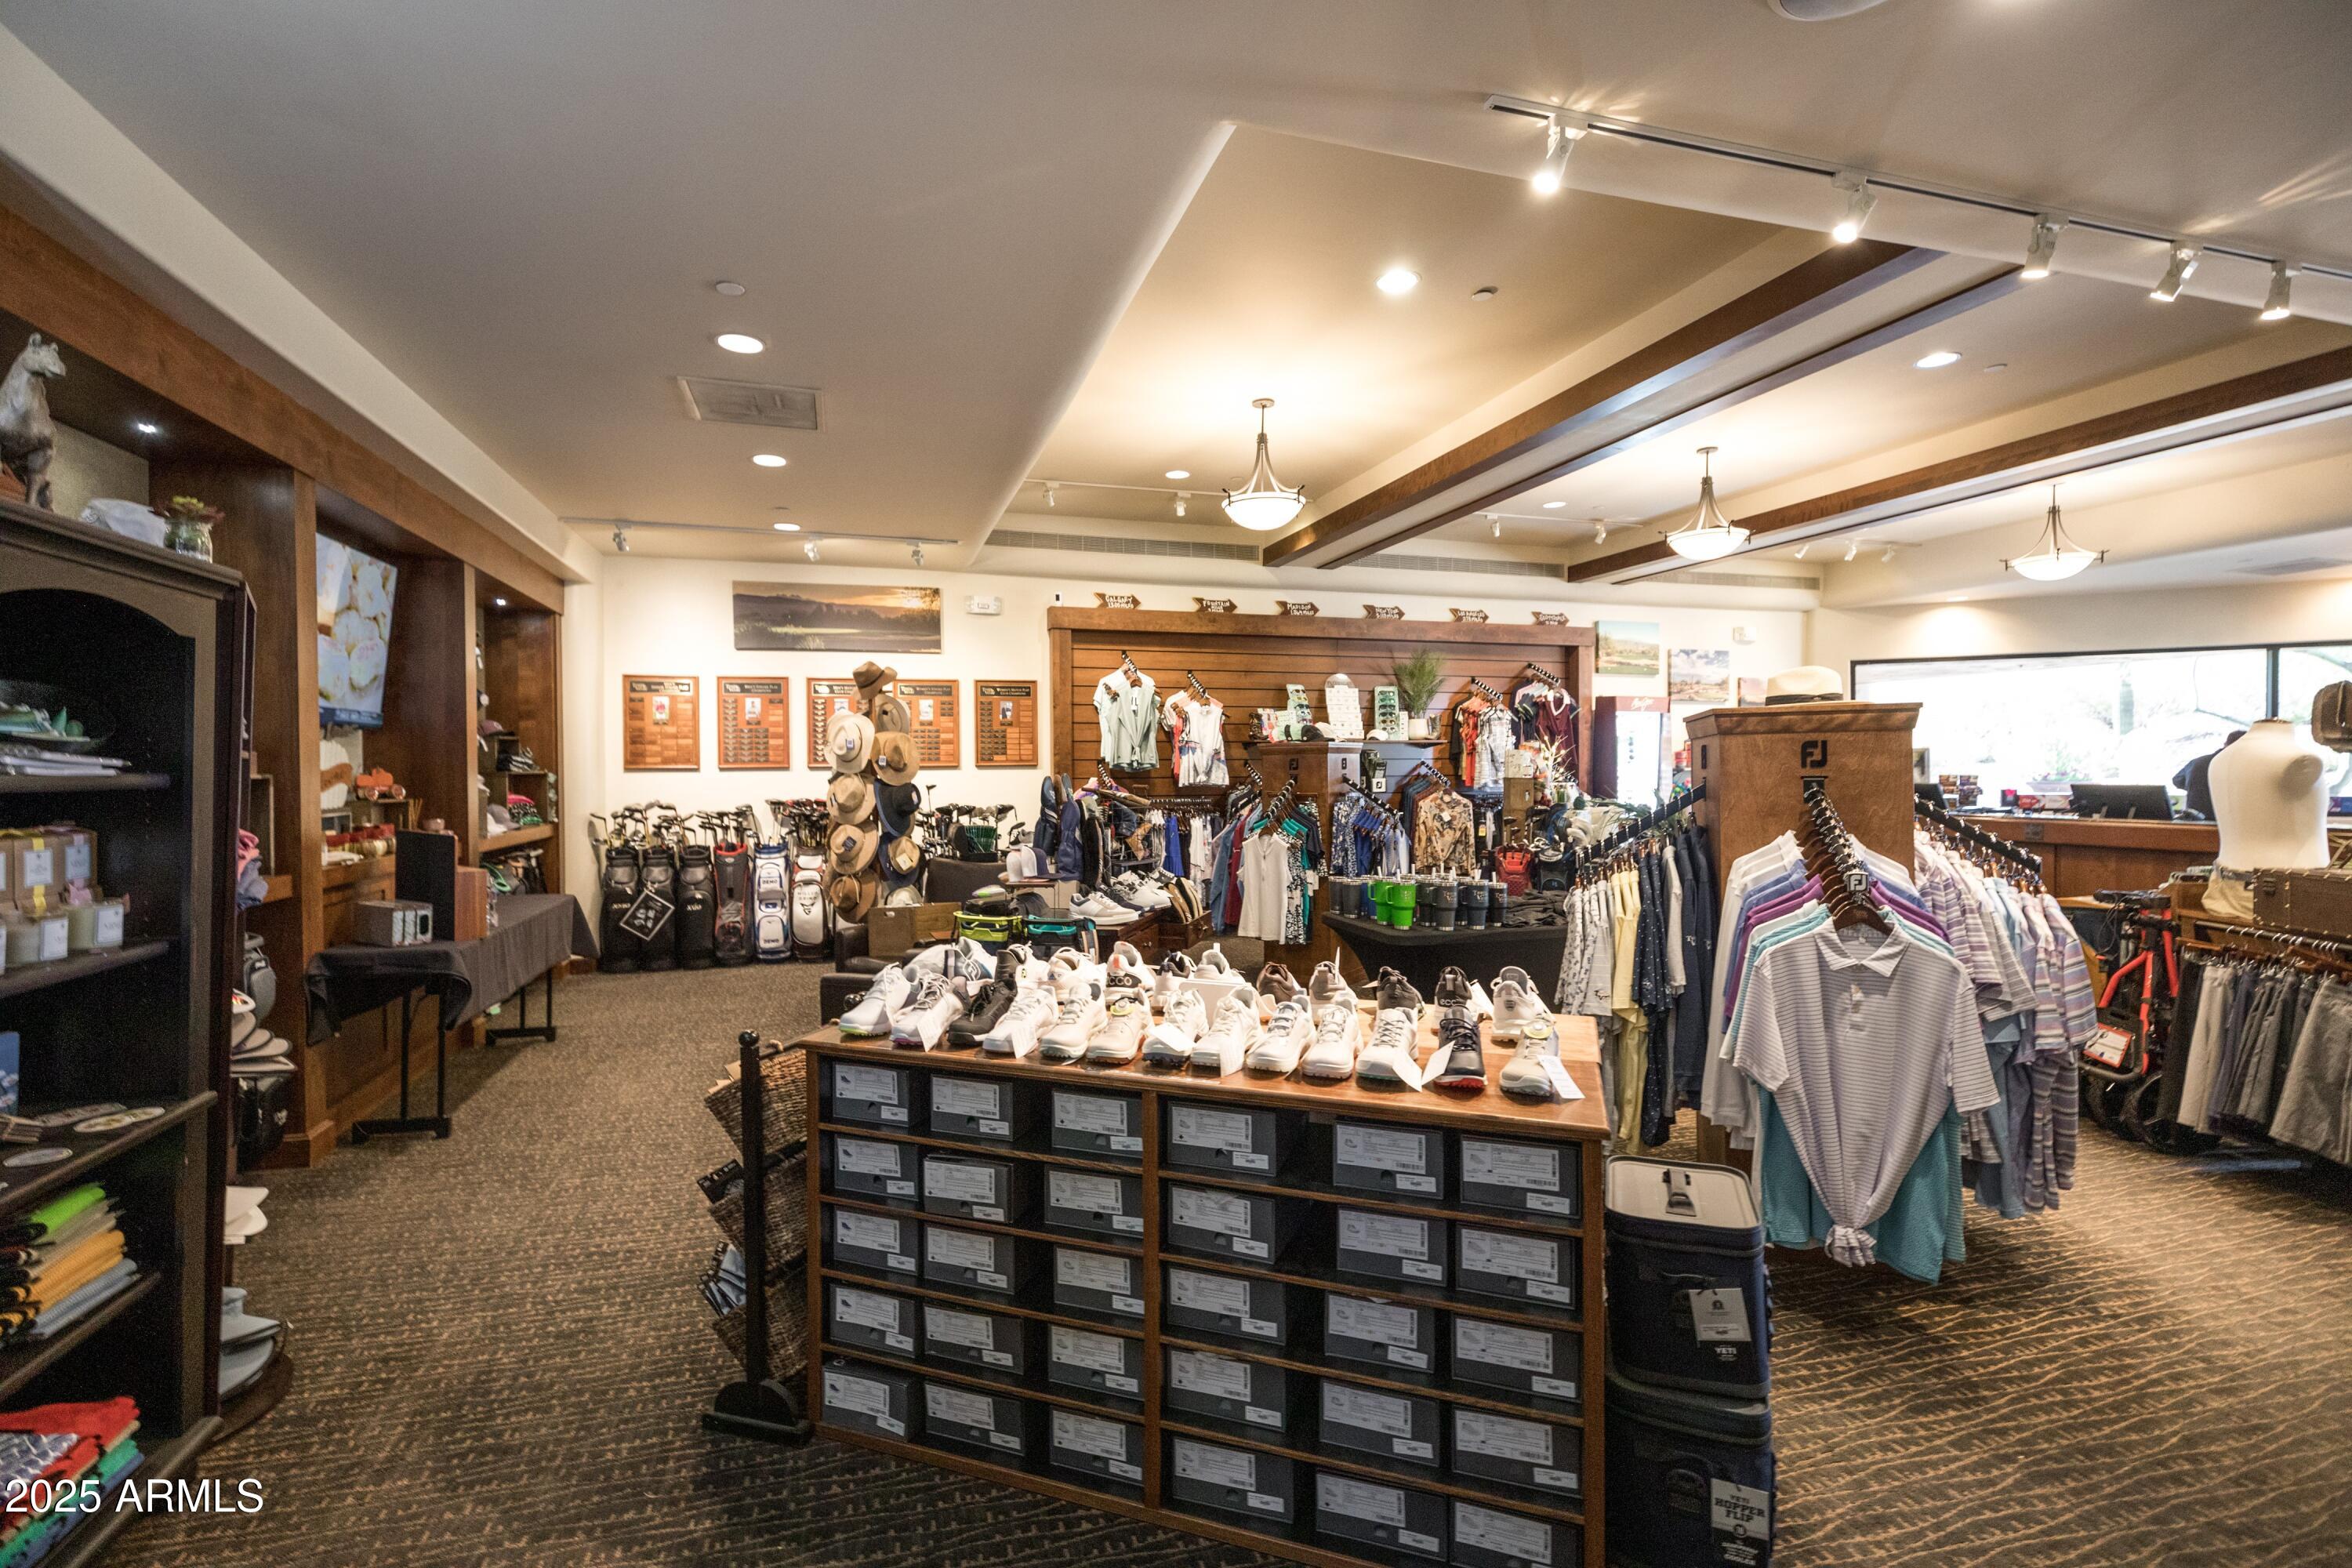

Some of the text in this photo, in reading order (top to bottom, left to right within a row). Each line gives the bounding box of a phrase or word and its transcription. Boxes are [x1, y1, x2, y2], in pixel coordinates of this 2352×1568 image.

[1801, 740, 1828, 768] FJ
[1289, 757, 1299, 771] FJ
[1850, 874, 1867, 891] FJ
[1730, 1494, 1750, 1504] YETI
[1715, 1497, 1766, 1518] HOPPER
[1725, 1509, 1755, 1523] FLIP
